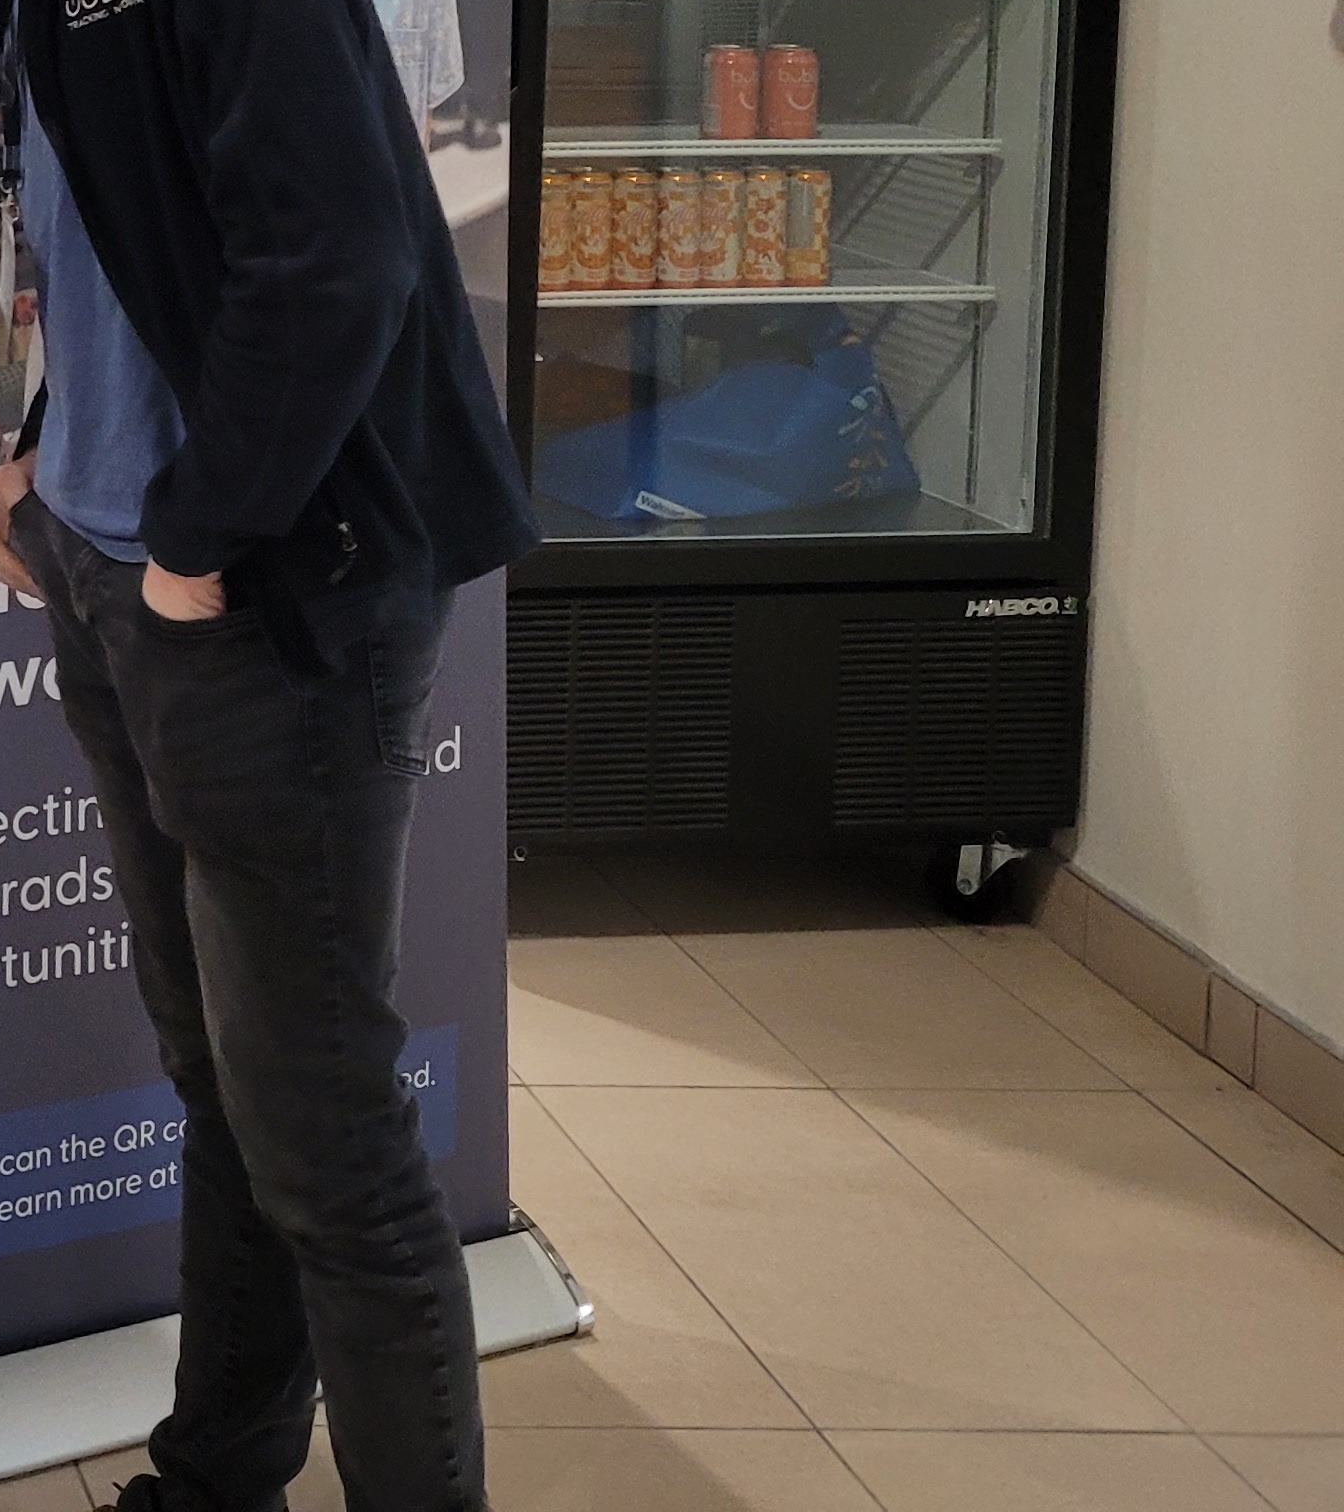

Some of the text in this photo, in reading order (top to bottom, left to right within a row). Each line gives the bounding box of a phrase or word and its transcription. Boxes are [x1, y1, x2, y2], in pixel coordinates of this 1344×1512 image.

[965, 596, 1059, 618] HABCO
[59, 1133, 107, 1163] the
[113, 1119, 156, 1152] QR
[70, 1174, 143, 1206] more
[149, 1161, 179, 1190] at
